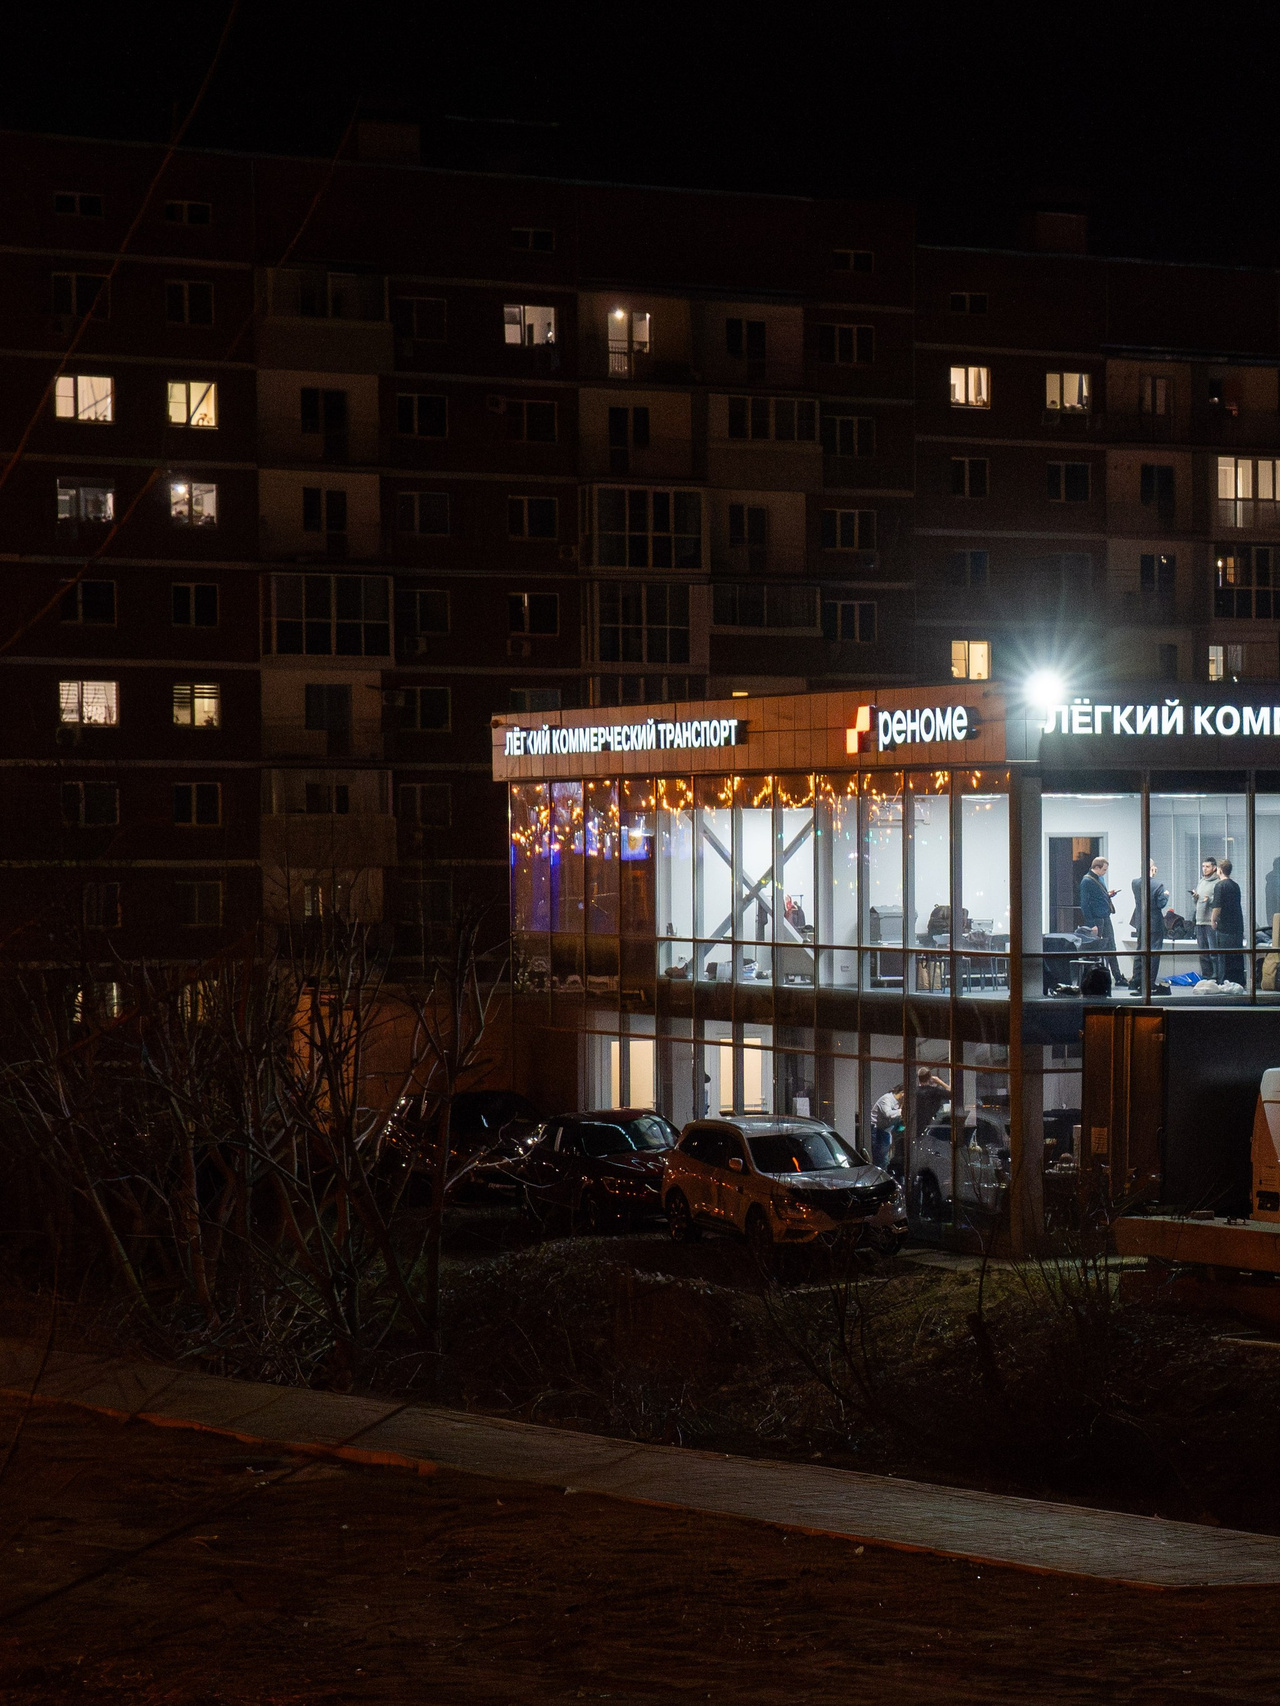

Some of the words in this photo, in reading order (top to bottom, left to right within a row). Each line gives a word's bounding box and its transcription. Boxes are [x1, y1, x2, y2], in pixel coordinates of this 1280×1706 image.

[878, 705, 968, 752] реноме
[1044, 698, 1184, 735] ЛЁГКИЙ
[504, 724, 551, 756] ЛЁГКИЙ
[552, 718, 656, 755] КОММЕРЧЕСКИЙ
[658, 718, 738, 750] ТРАНСПОРТ
